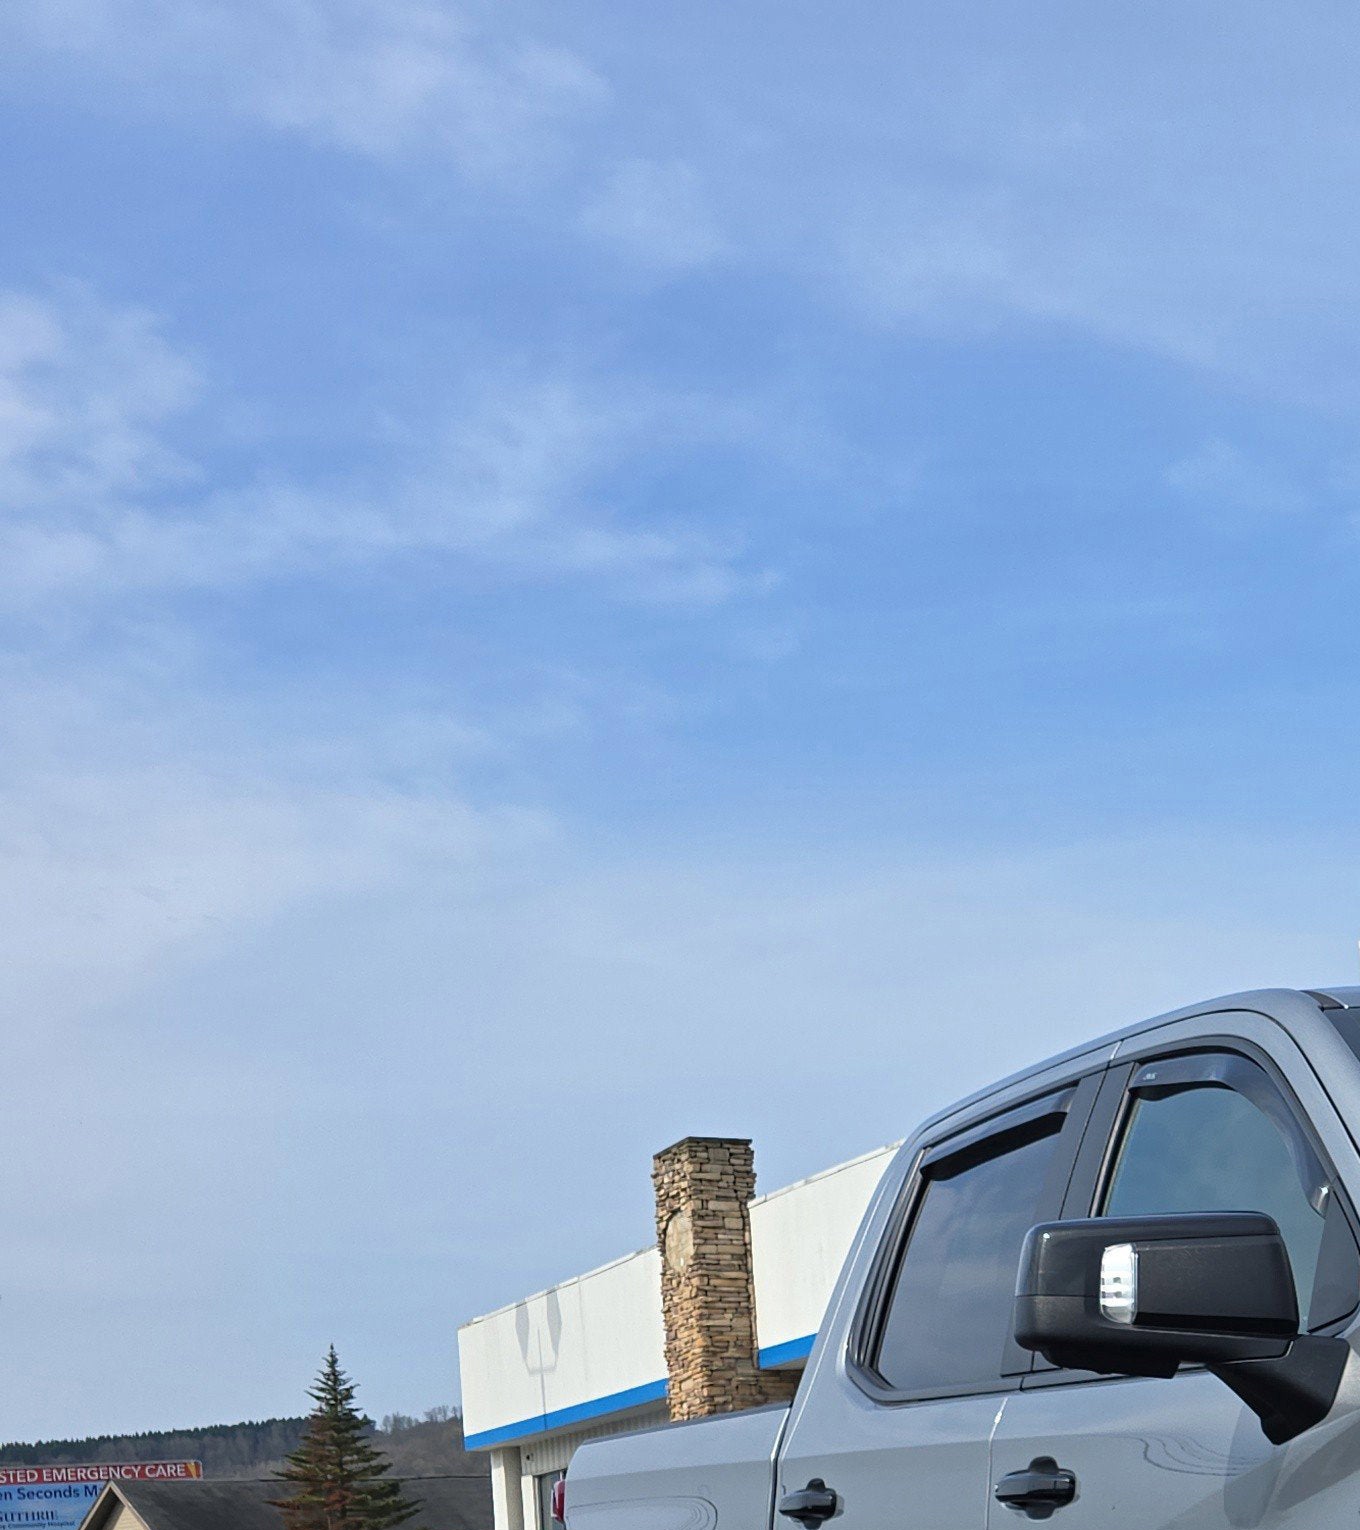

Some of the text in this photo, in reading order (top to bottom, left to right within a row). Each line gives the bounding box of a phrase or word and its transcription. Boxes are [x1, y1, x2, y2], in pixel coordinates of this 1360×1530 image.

[42, 1466, 141, 1482] EMERGENCY
[145, 1464, 186, 1478] CARE
[17, 1486, 80, 1501] Seconds
